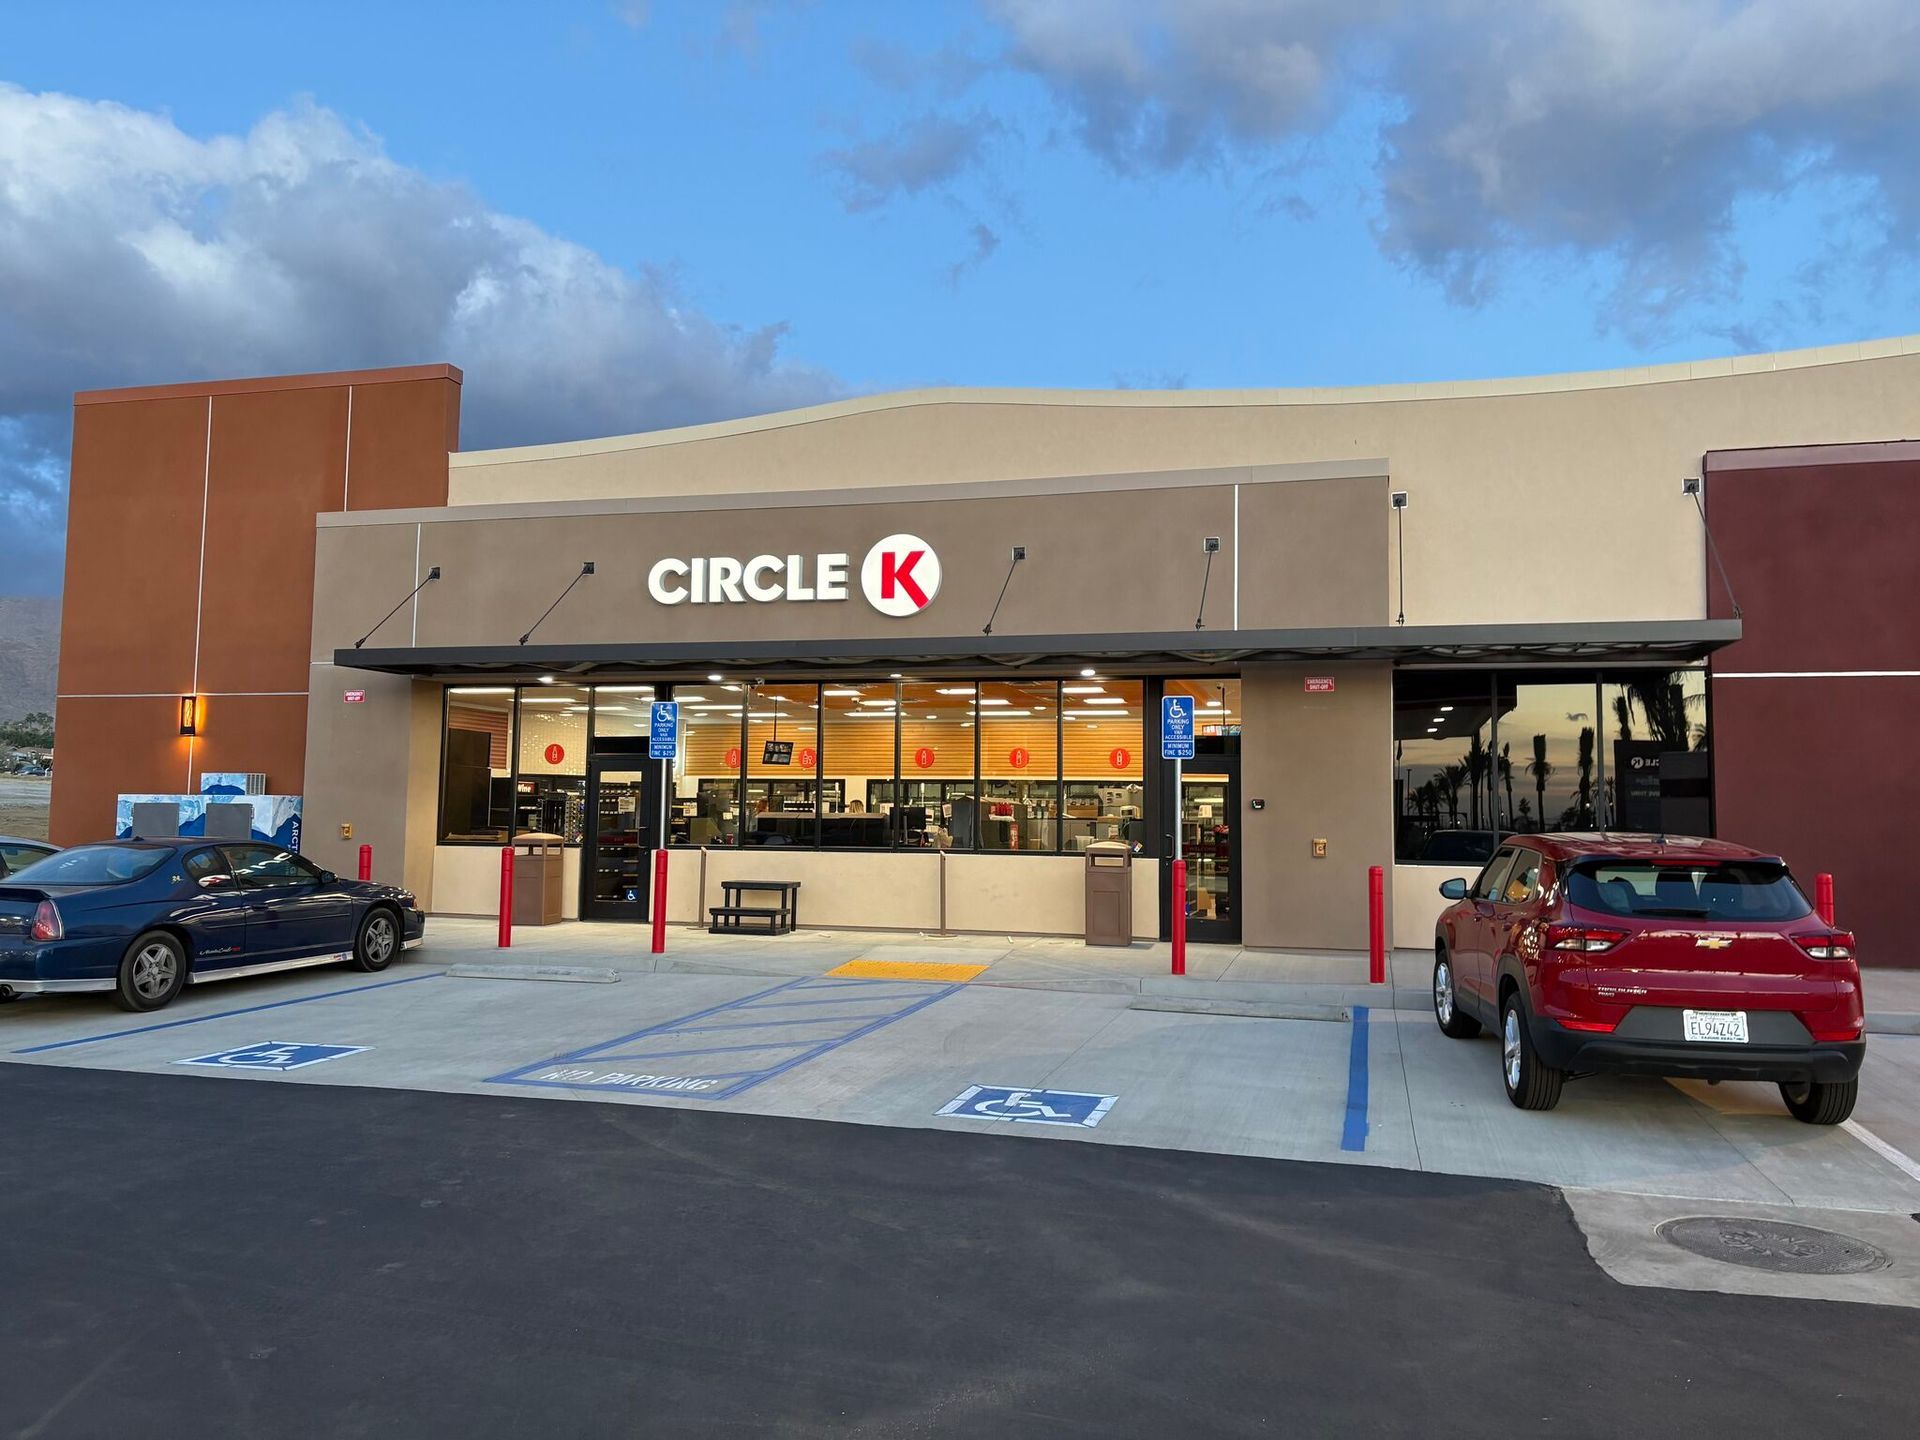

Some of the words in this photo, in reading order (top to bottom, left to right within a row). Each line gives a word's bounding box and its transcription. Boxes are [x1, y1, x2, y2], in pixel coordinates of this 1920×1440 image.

[648, 553, 849, 604] CIRCLE
[881, 550, 930, 609] K
[1690, 1021, 1741, 1037] EL94Z42
[590, 1072, 718, 1090] PARKING
